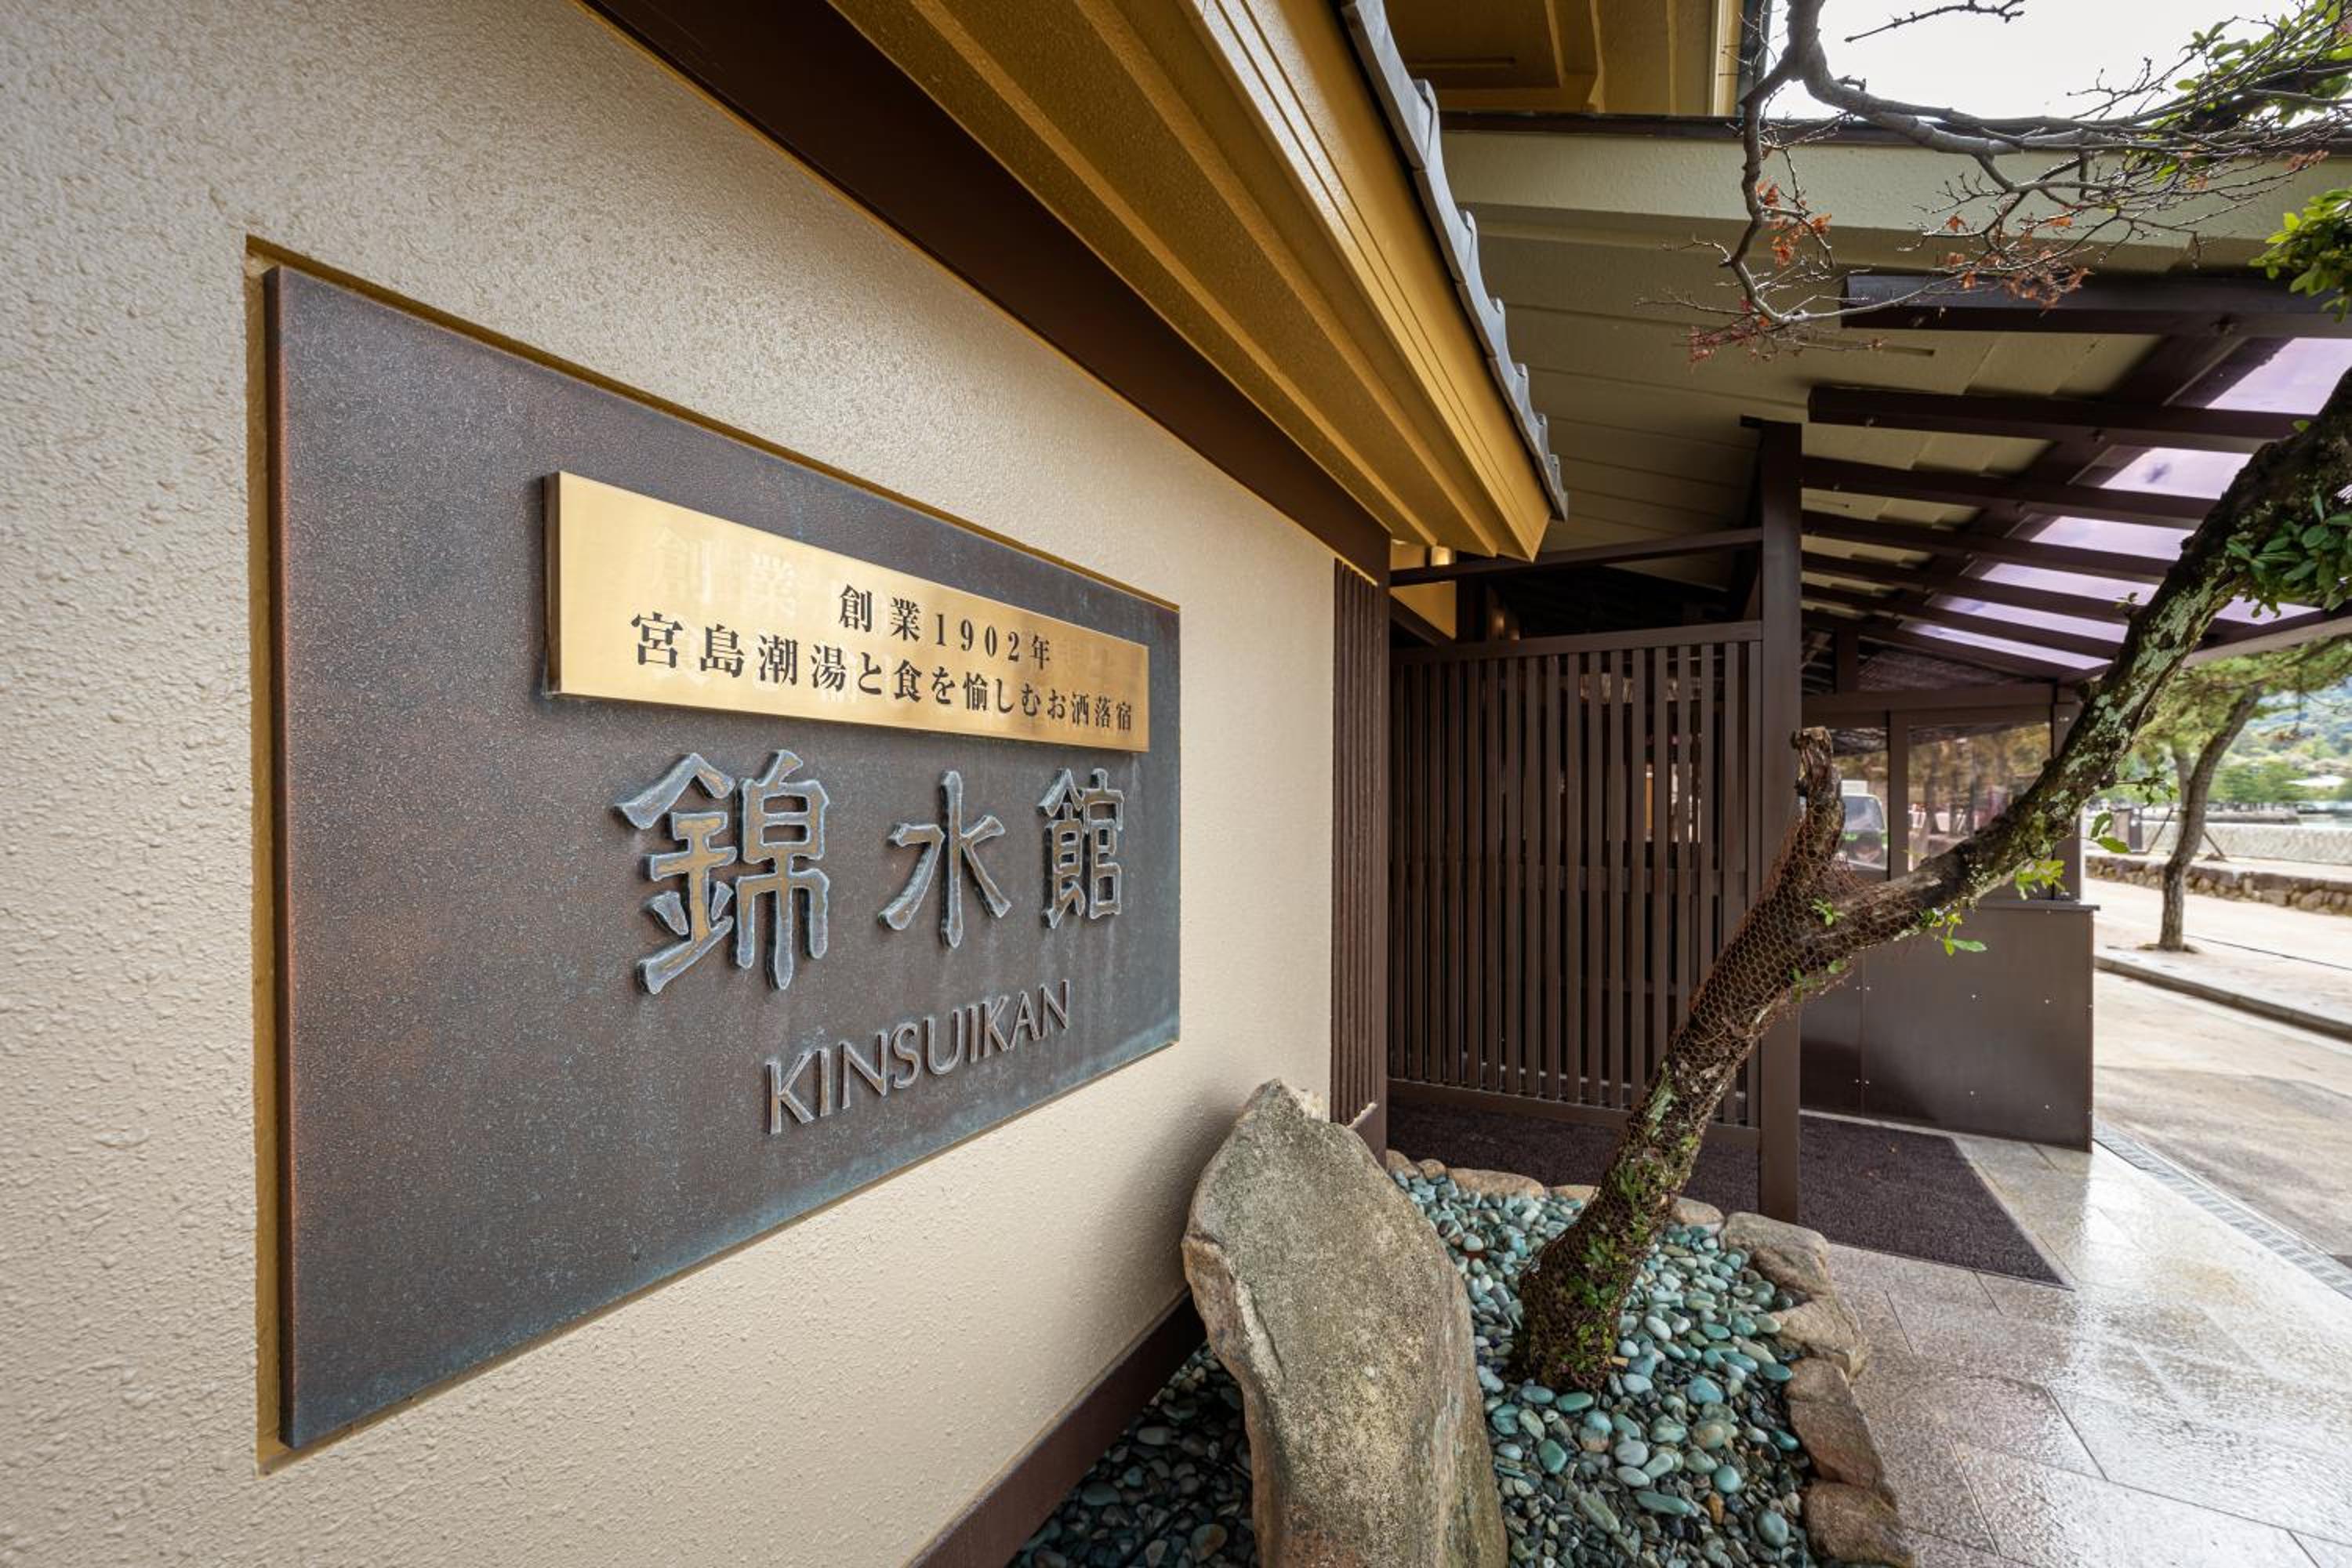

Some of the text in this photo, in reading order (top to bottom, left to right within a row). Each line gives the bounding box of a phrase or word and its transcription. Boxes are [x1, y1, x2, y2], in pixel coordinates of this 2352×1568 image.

[630, 612, 1134, 732] 宮島潮湯と食を愉しむお洒落宿
[837, 583, 1052, 672] 創業1902年
[613, 750, 1126, 994] 錦水館
[764, 978, 1070, 1134] KINSUIKAN
